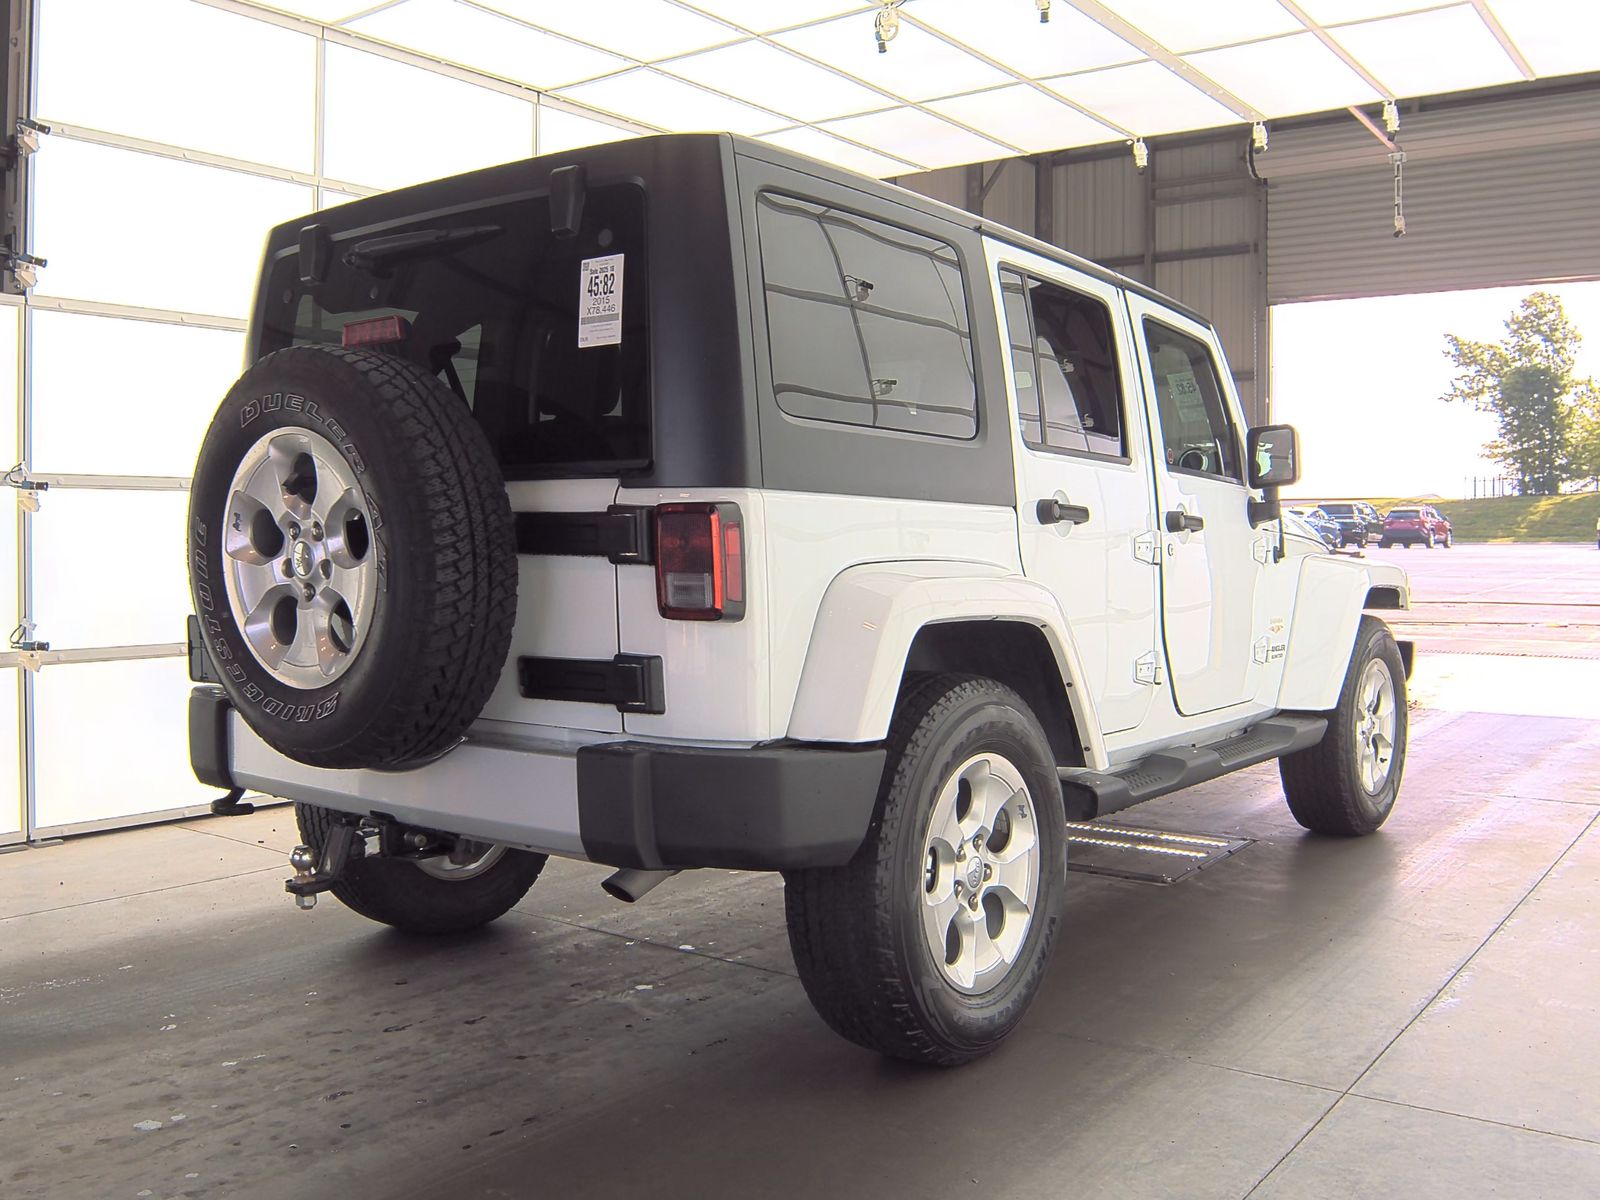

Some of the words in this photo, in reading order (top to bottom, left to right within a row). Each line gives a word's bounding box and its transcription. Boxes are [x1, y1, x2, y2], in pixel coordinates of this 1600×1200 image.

[588, 273, 615, 296] 45:82
[592, 295, 610, 306] 2015
[241, 393, 366, 474] DUELER
[195, 516, 339, 722] BRIDGESTONE
